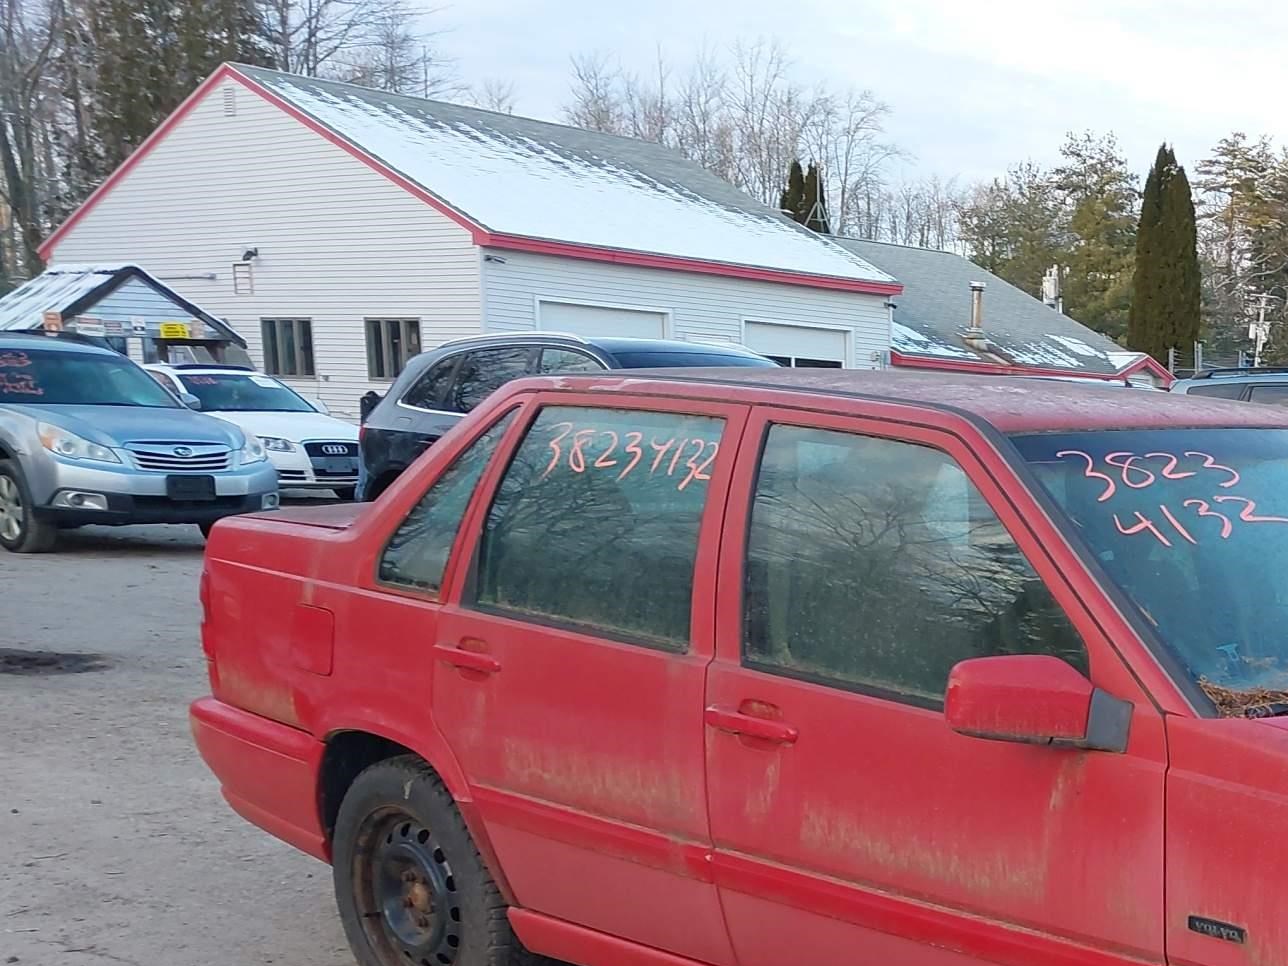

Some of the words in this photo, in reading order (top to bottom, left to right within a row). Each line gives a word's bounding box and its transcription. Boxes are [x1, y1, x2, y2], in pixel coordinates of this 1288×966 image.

[540, 421, 719, 491] 38234132
[1056, 451, 1240, 501] 3823
[1194, 920, 1240, 940] VOLVO
